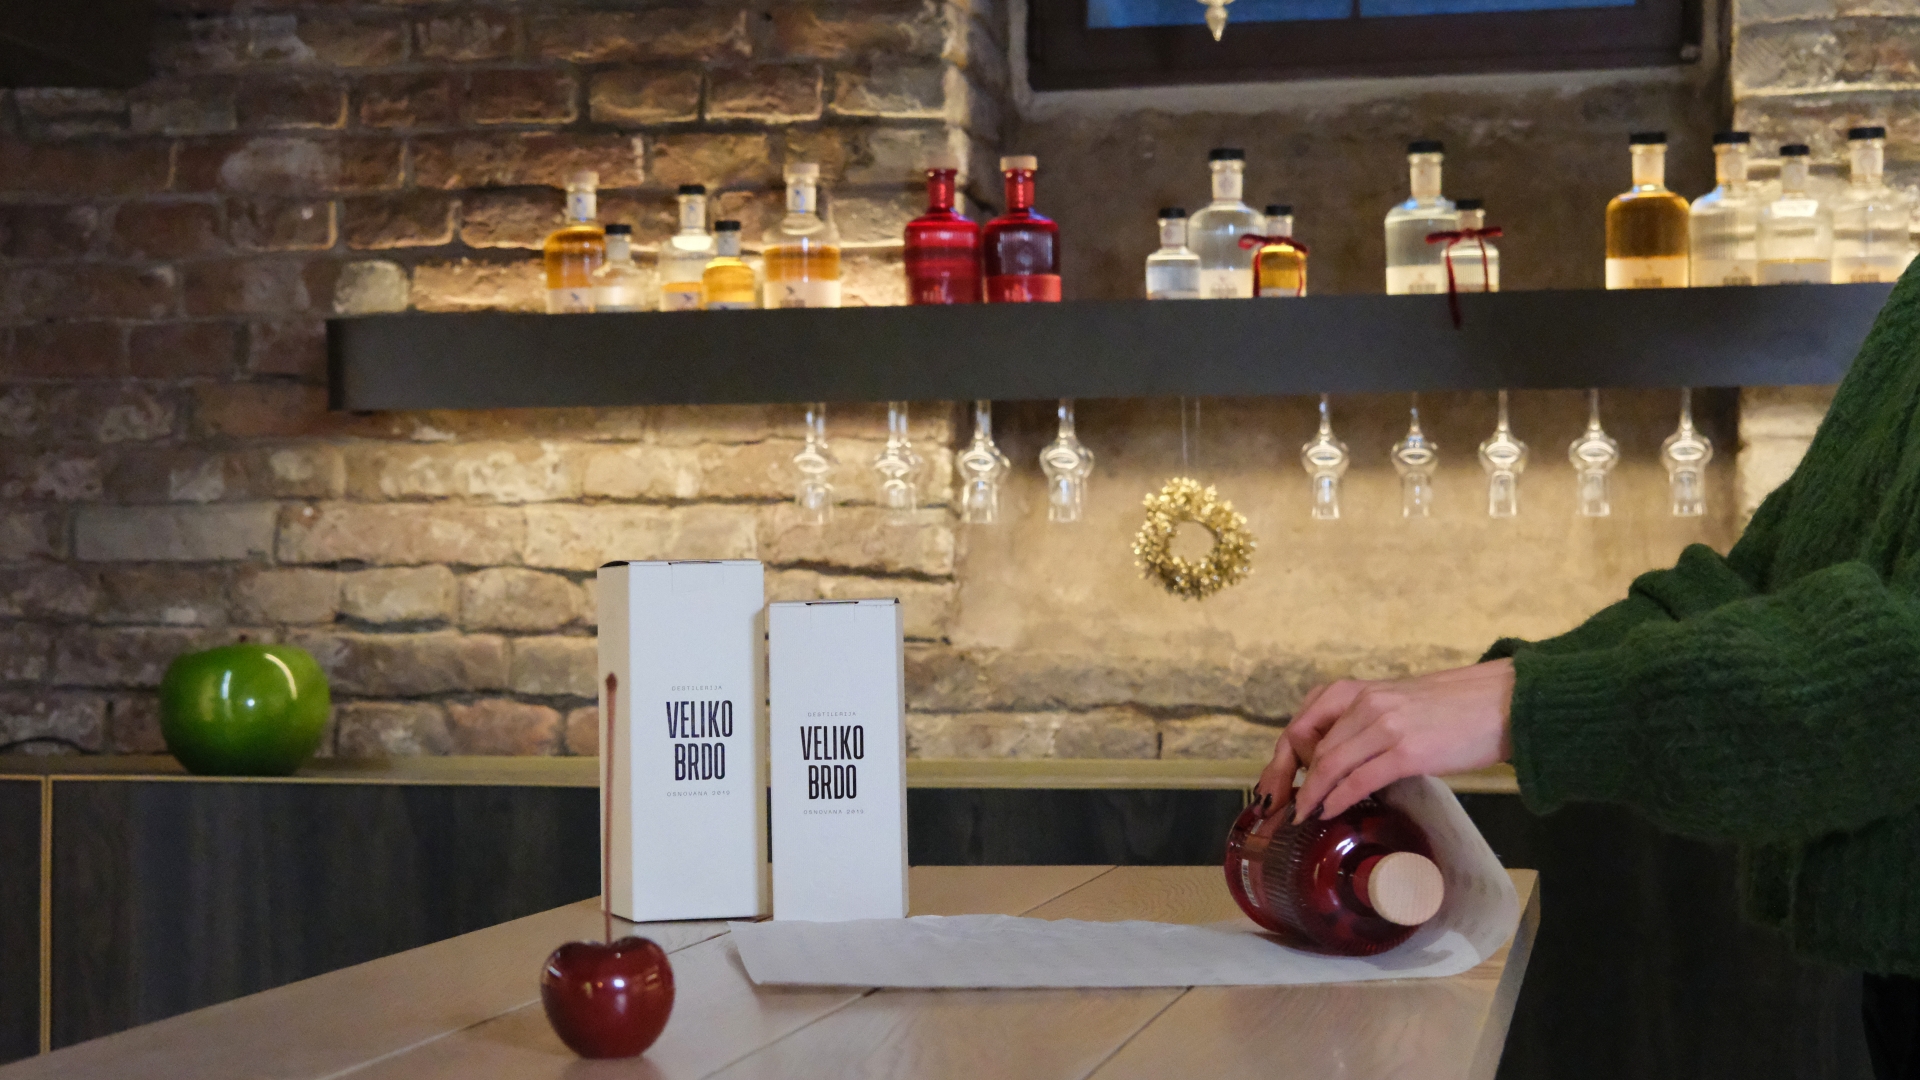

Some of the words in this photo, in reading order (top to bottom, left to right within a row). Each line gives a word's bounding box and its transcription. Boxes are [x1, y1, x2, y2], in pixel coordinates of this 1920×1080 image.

[666, 700, 733, 738] VELIKO
[800, 725, 864, 760] VELIKO
[674, 742, 726, 781] BRDO
[808, 764, 857, 800] BRDO
